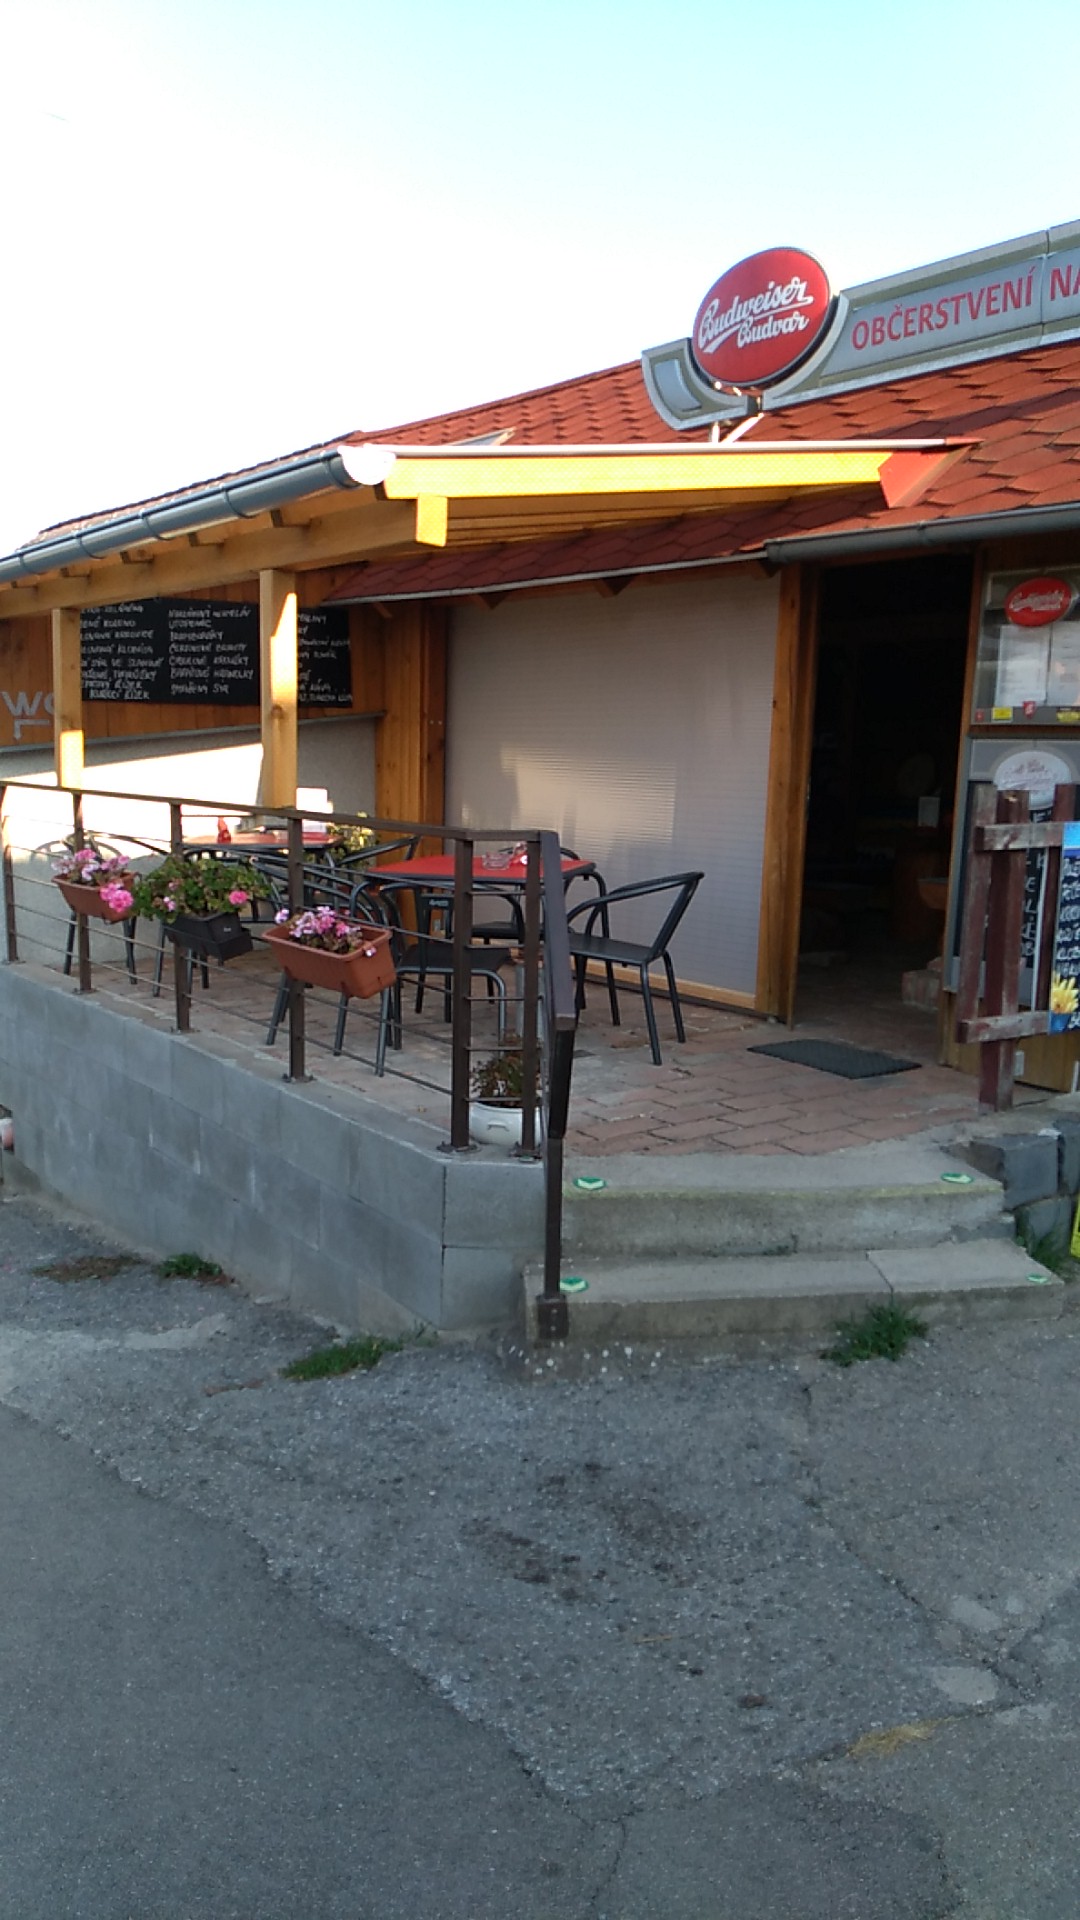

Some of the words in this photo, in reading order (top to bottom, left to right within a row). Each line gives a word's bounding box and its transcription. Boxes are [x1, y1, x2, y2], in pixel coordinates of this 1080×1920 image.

[699, 276, 813, 353] Budweiser
[737, 312, 809, 348] Budvar
[852, 266, 1036, 350] OBČERSTVENÍ
